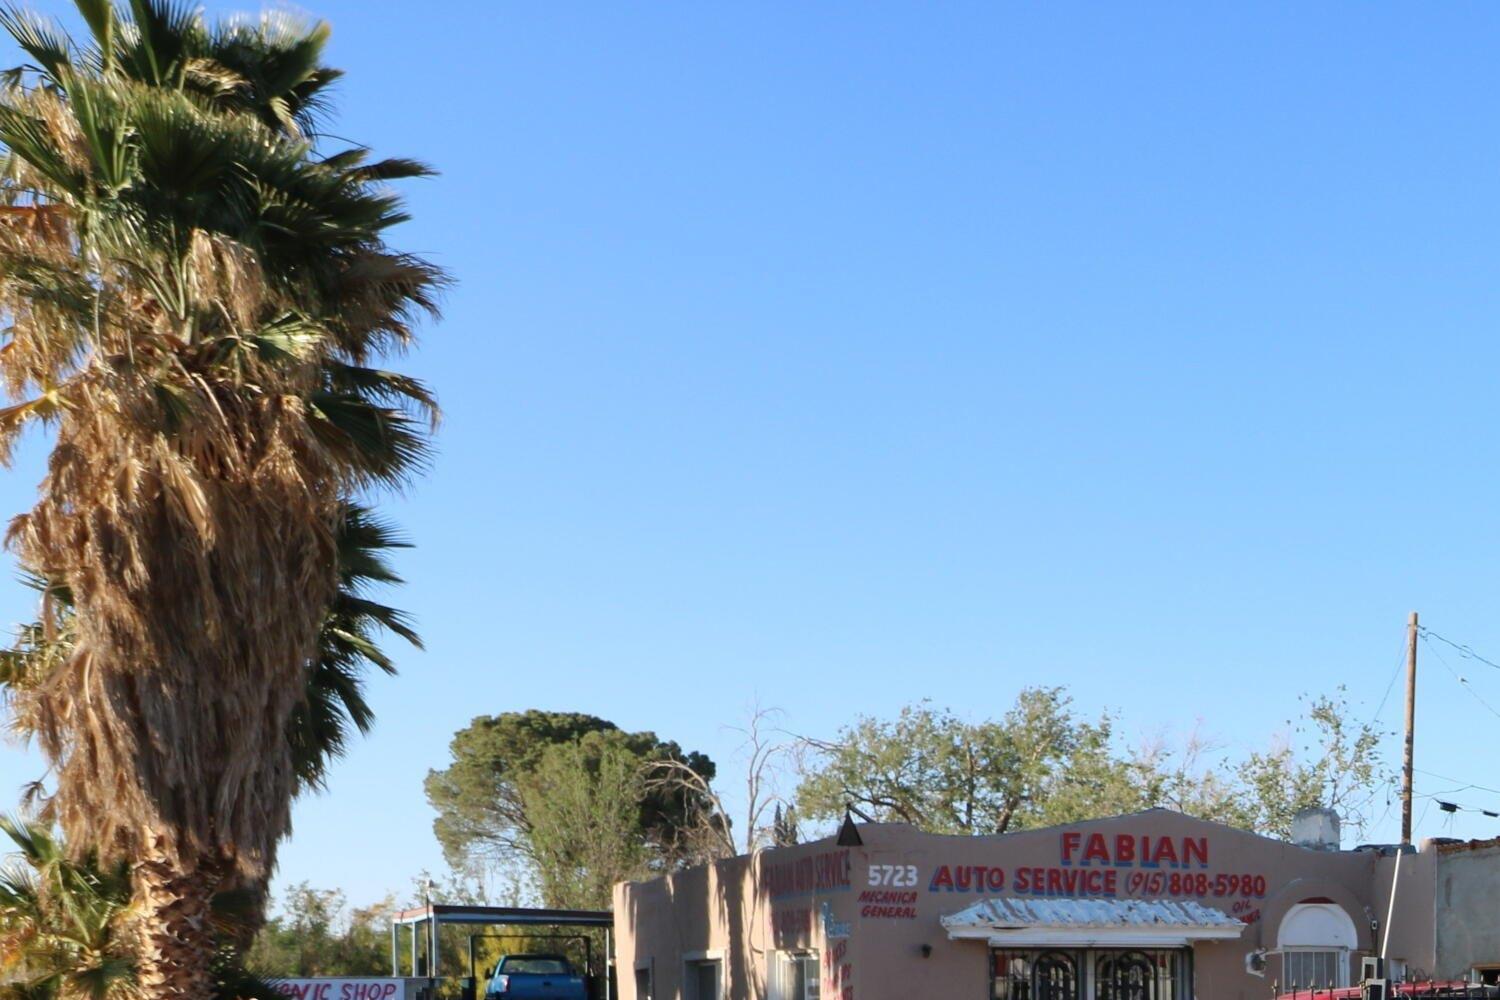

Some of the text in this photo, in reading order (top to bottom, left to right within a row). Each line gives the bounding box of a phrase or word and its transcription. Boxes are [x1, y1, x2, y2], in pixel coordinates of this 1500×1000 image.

[1060, 832, 1209, 868] FABIAN
[867, 864, 919, 888] 5723
[928, 864, 1005, 893] AUTO
[1013, 867, 1117, 898] SERVICE
[857, 890, 918, 903] MECANICA
[861, 904, 919, 919] GENERAL
